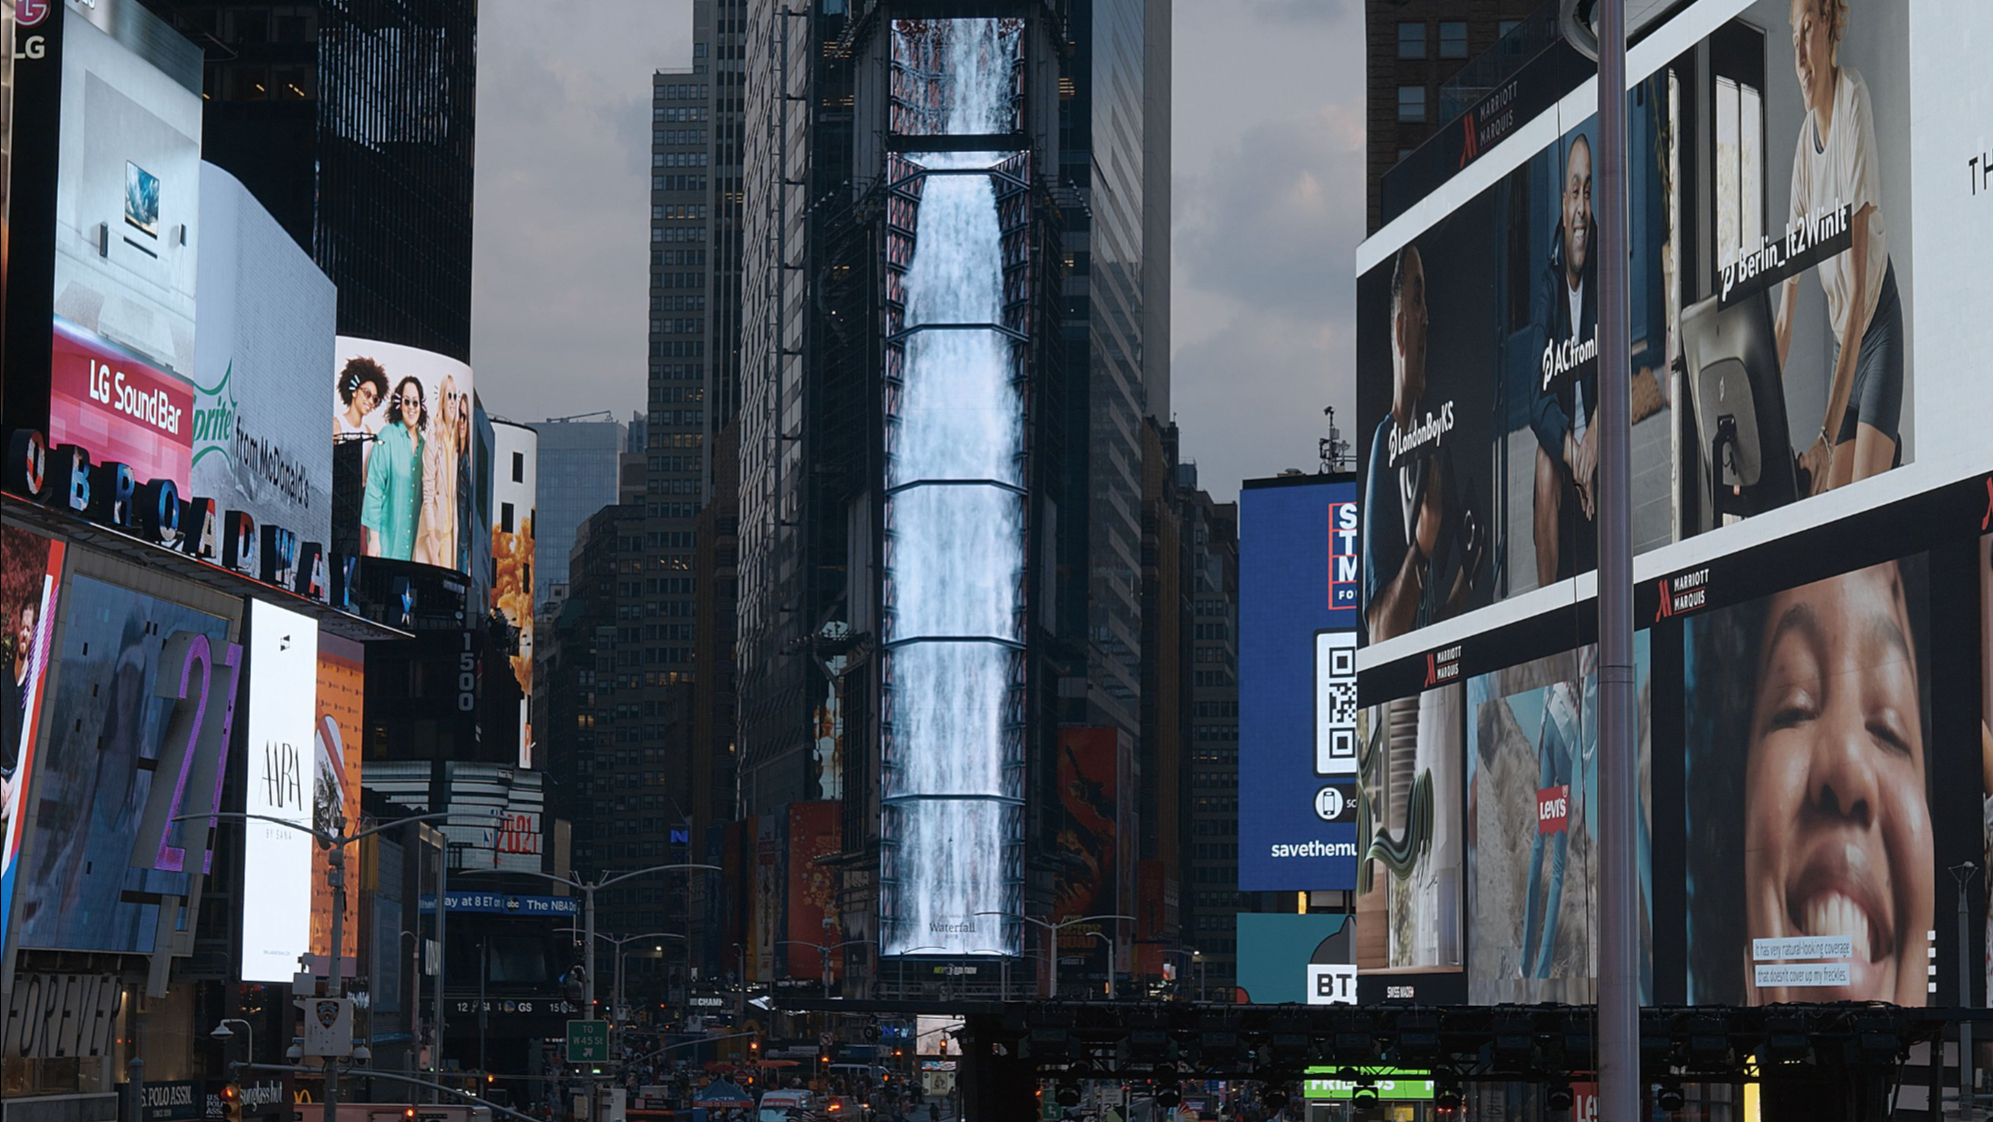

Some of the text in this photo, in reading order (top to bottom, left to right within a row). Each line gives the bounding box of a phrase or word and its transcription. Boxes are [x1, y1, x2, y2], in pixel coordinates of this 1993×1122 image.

[13, 35, 46, 59] LG
[1480, 80, 1518, 122] MARRIOTT
[1480, 109, 1514, 147] MARQUIS
[1738, 197, 1848, 283] Berlin_It2WinIt
[1554, 323, 1598, 376] ACfrom
[89, 358, 111, 404] LG
[193, 394, 232, 441] prite
[1397, 400, 1454, 455] LondonBoyKS
[235, 415, 310, 509] from McDonald's
[1674, 568, 1710, 592] MARRIOTT
[1338, 590, 1357, 600] FO
[1674, 589, 1705, 611] MARQUIS
[1437, 644, 1462, 664] MARRIOTT
[458, 632, 475, 711] 1500
[1437, 662, 1459, 680] MARQUIS
[461, 897, 472, 906] at
[474, 897, 481, 906] 8
[483, 898, 493, 907] ET
[527, 900, 548, 910] The
[551, 901, 568, 911] NBA
[929, 922, 976, 933] Waterfall
[1825, 942, 1850, 958] coverage
[2, 973, 123, 1058] FOREVER
[457, 1003, 468, 1012] 12
[518, 1003, 532, 1012] GS
[572, 1036, 580, 1045] W
[581, 1036, 593, 1045] 45
[595, 1036, 603, 1045] St
[583, 1025, 594, 1034] TO
[148, 1086, 170, 1107] POLO
